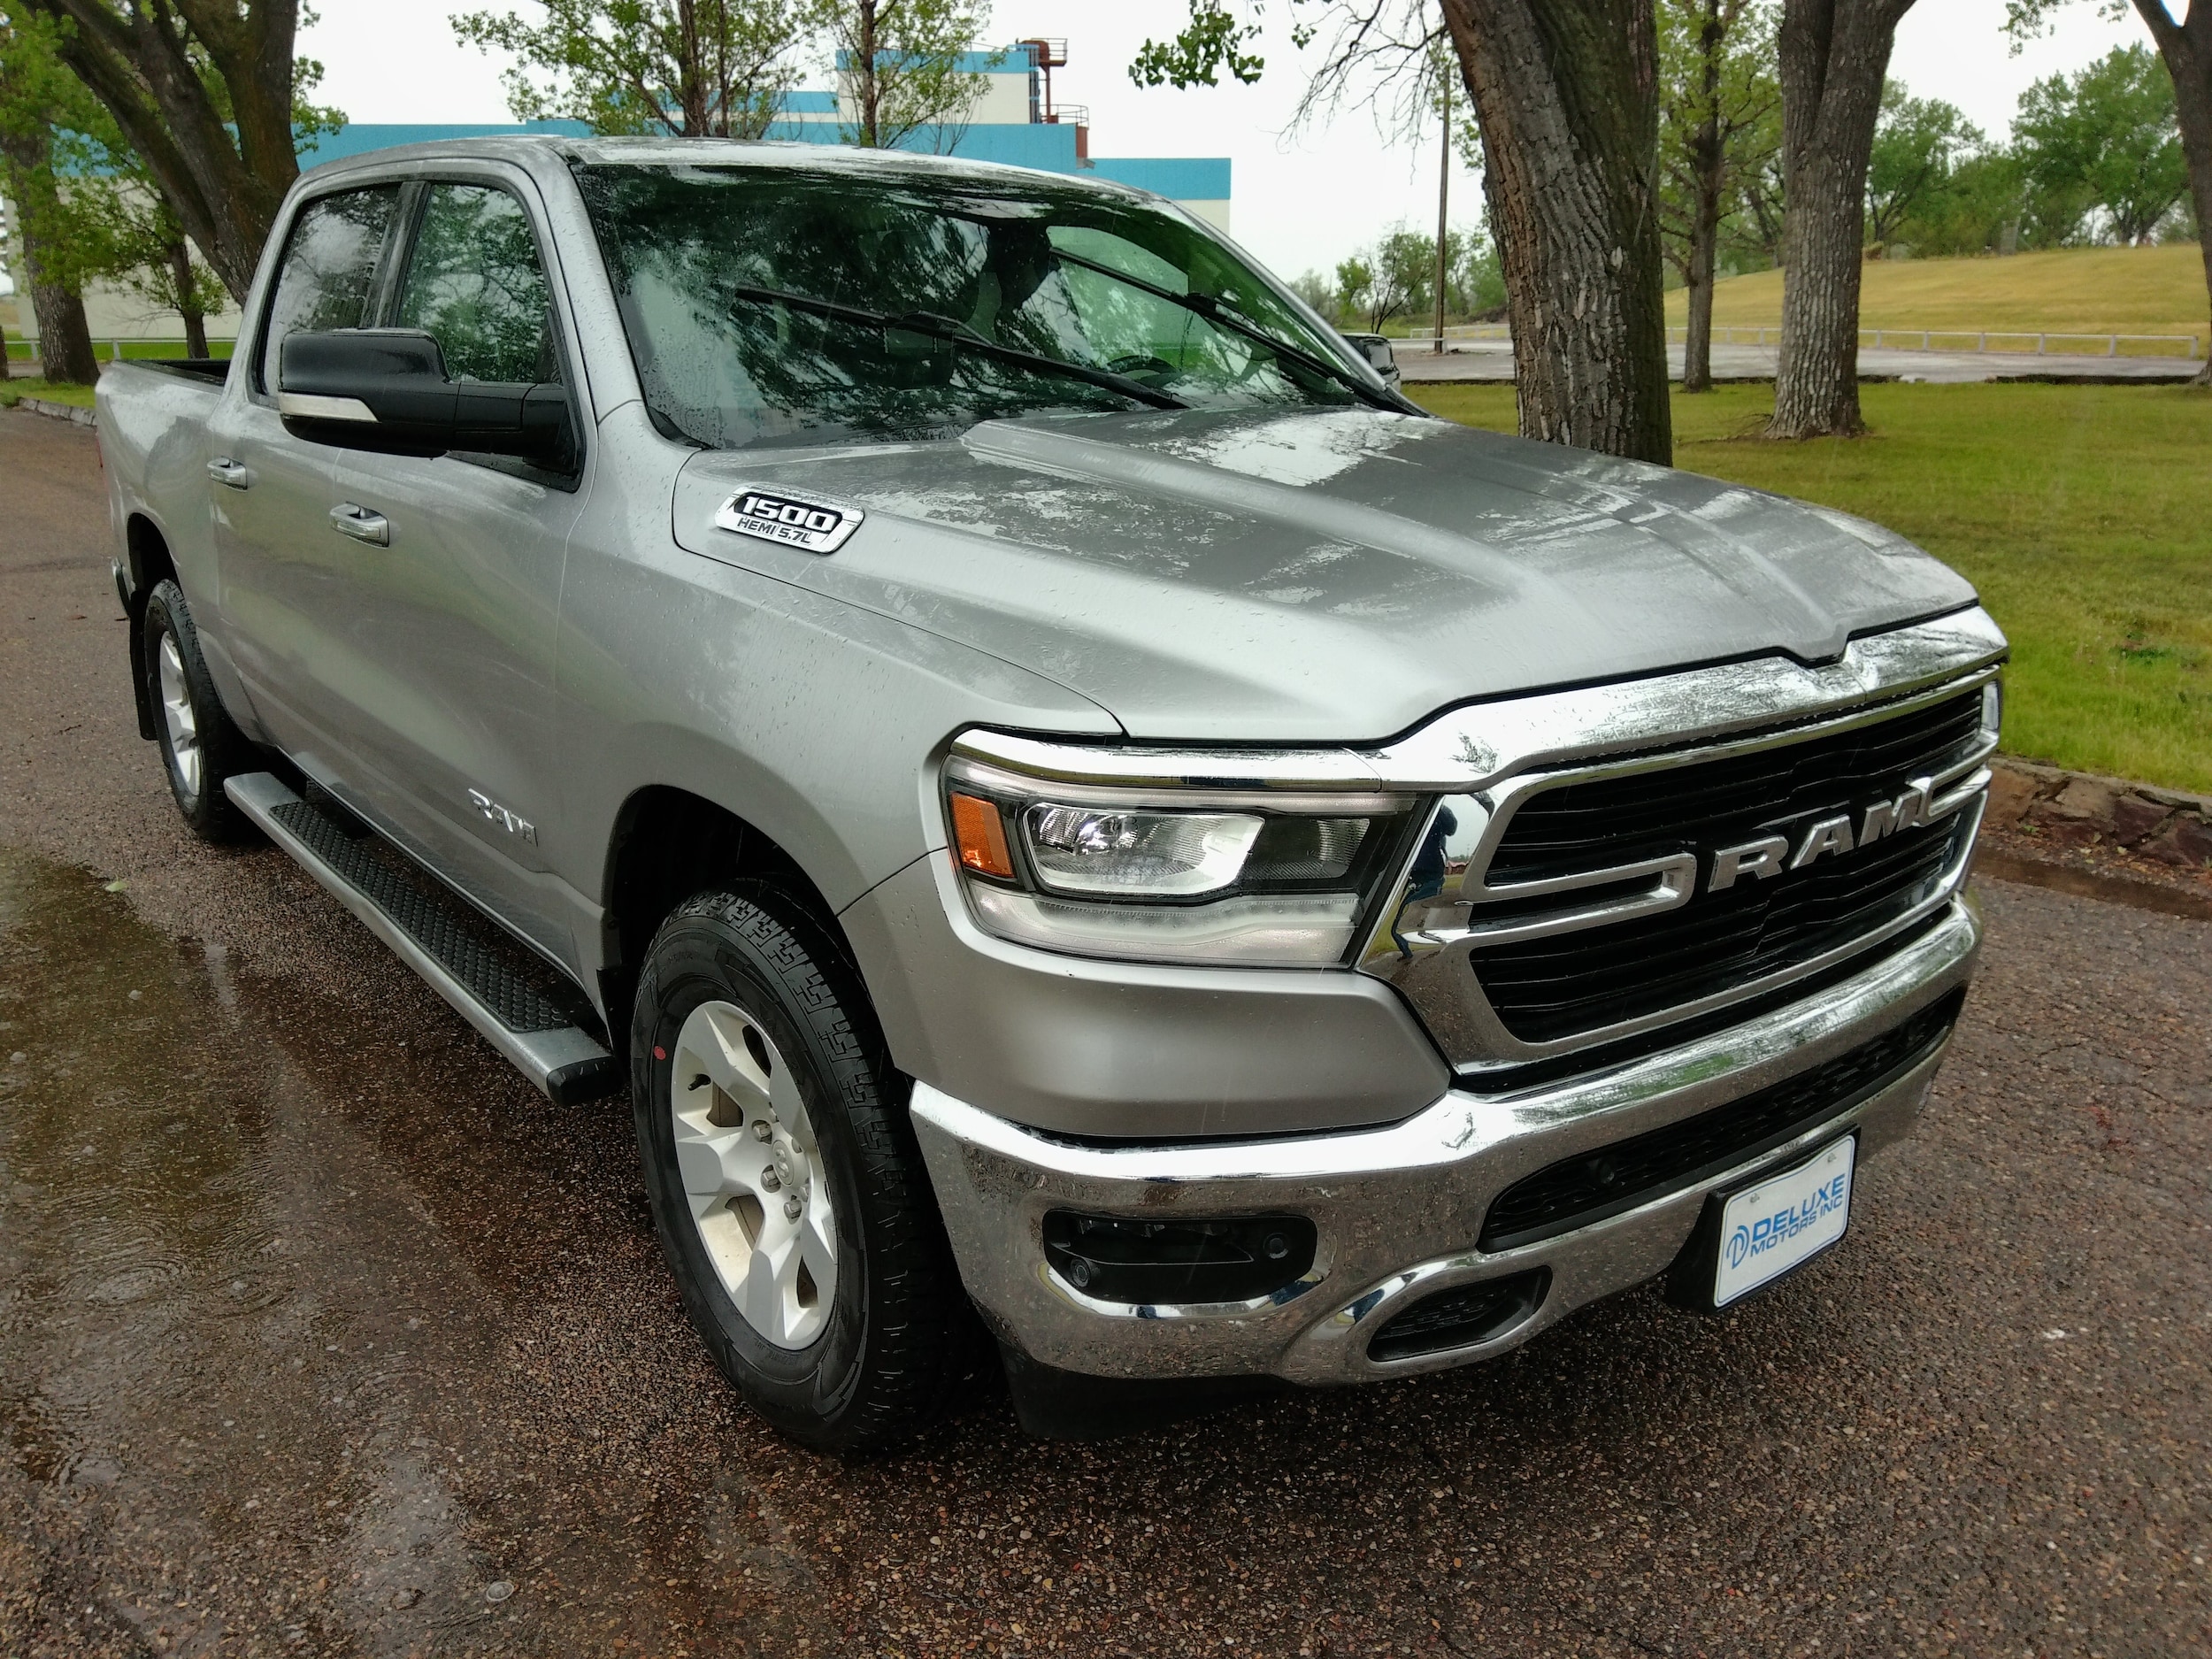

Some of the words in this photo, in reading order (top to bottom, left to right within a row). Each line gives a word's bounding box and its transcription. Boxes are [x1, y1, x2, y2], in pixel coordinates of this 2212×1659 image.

[737, 517, 778, 535] HEMI
[778, 527, 811, 544] 5.7L
[742, 496, 838, 531] 1500
[468, 787, 539, 847] RAM
[1708, 788, 1922, 893] RAM
[1750, 1210, 1817, 1257] MOTORS
[1819, 1194, 1843, 1218] INC
[1752, 1173, 1846, 1242] DELUXE
